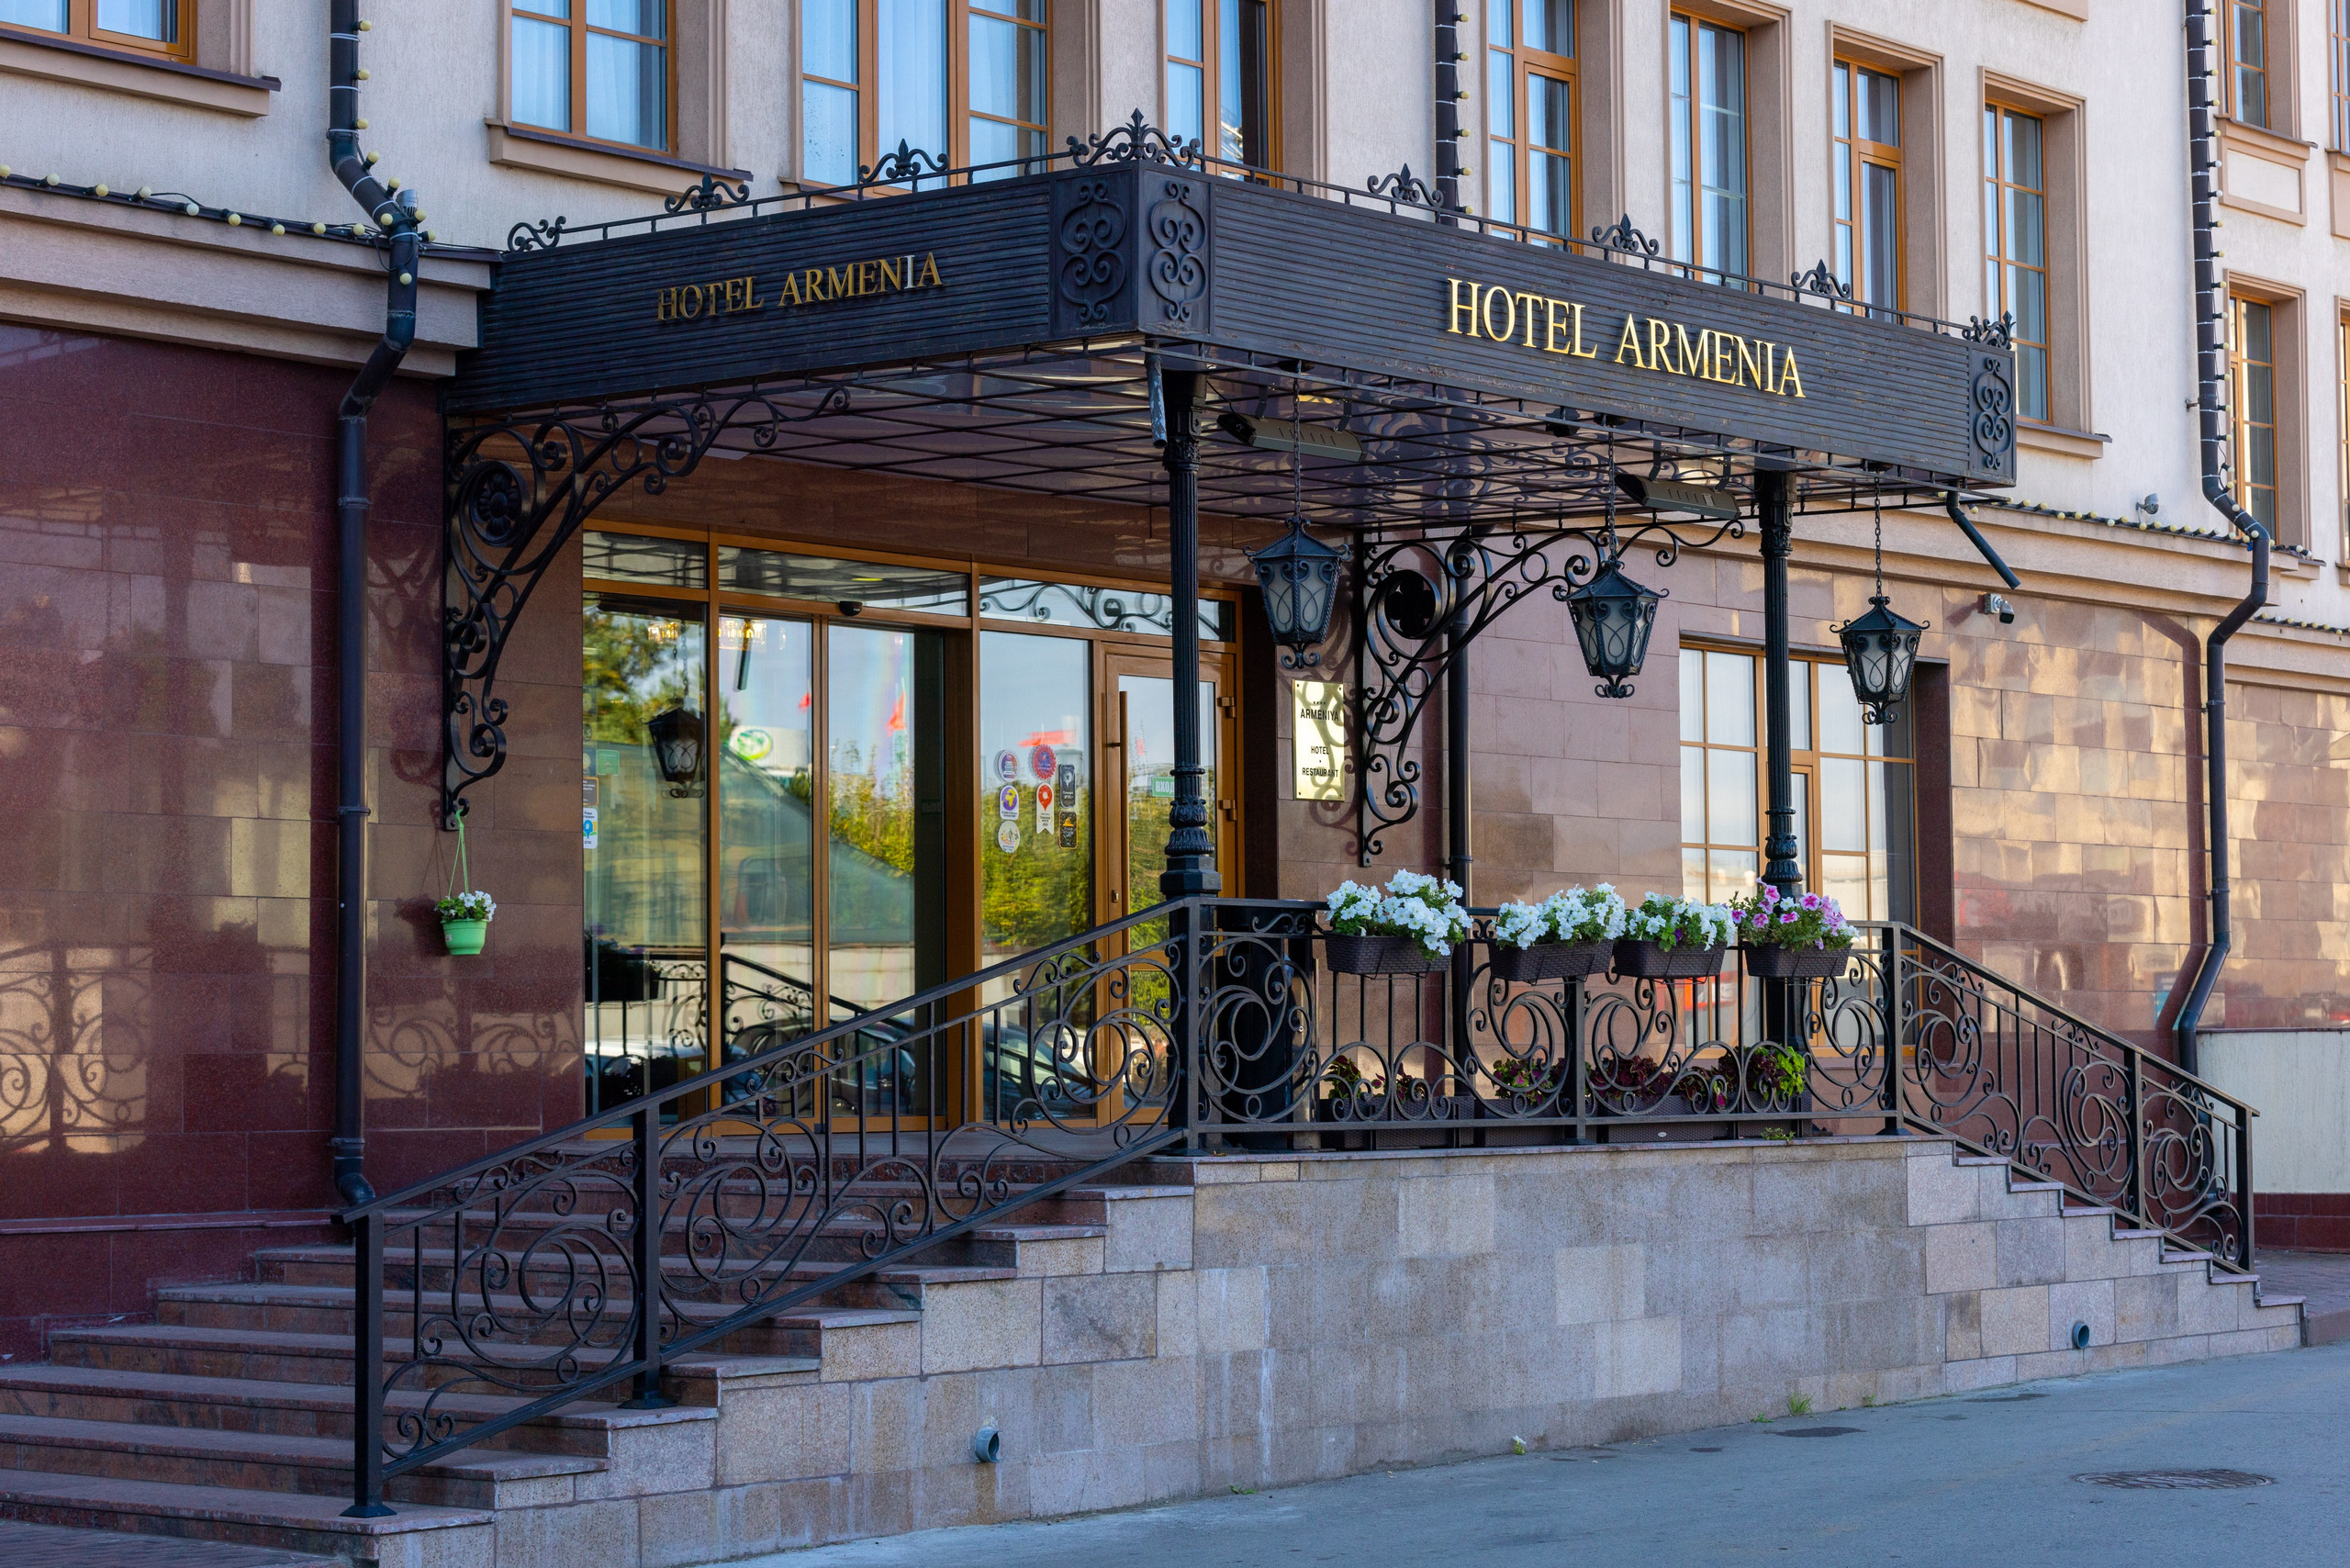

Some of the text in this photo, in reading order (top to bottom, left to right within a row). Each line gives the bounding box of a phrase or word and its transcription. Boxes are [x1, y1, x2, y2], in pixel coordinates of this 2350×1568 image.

[656, 252, 944, 322] HOTEL ARMENIA
[1447, 277, 1807, 398] HOTEL ARMENIA
[1300, 708, 1339, 722] ARMENIYA
[1310, 745, 1330, 756] HOTEL
[1302, 767, 1339, 778] RESTAURANT
